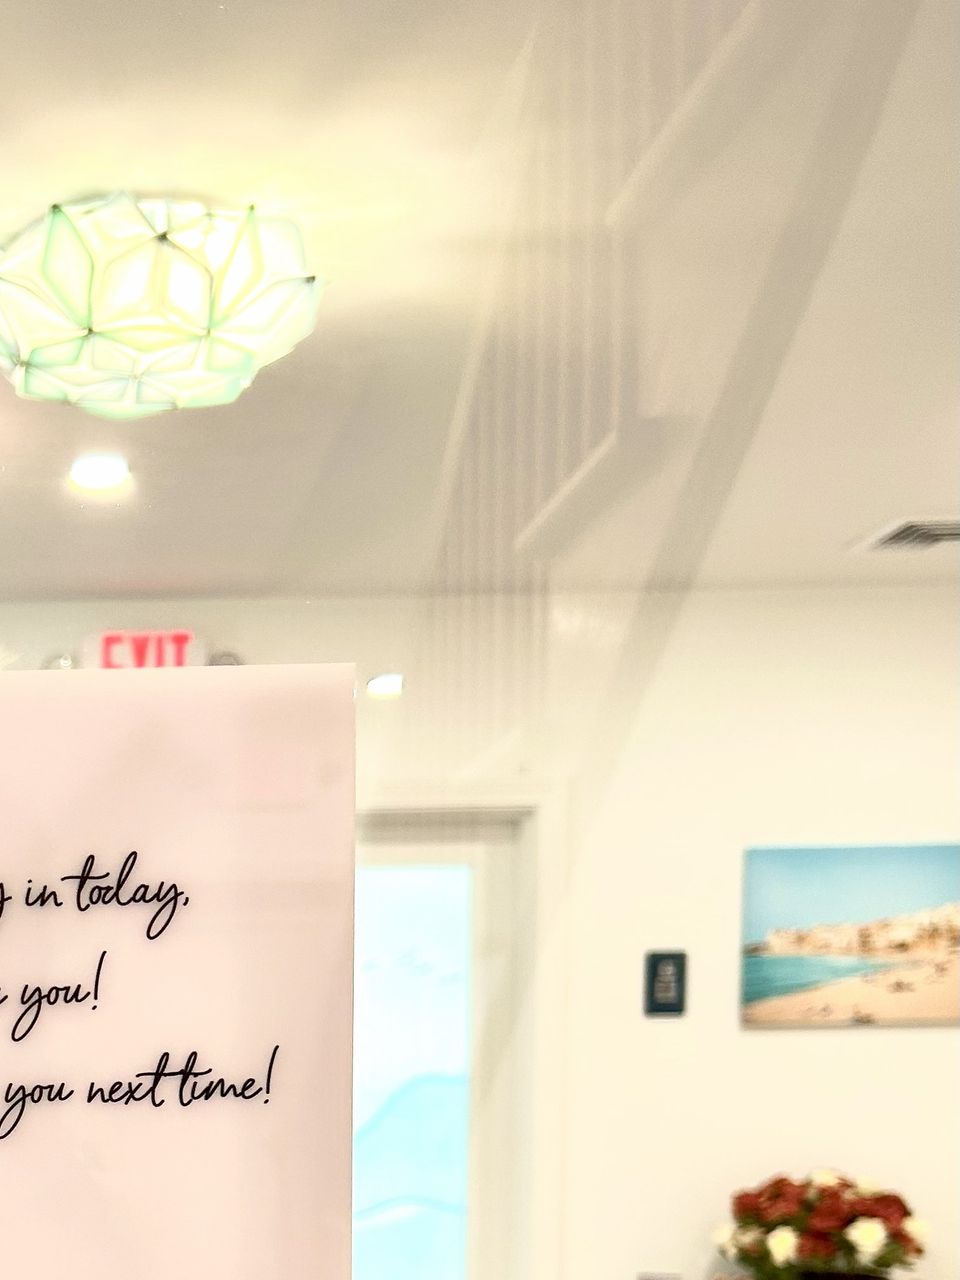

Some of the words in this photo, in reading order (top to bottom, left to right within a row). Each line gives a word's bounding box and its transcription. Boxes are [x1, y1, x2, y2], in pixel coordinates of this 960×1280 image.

[24, 879, 64, 908] in
[60, 850, 190, 940] today,
[10, 950, 108, 1042] you!
[86, 1051, 167, 1108] next
[174, 1044, 281, 1107] time!
